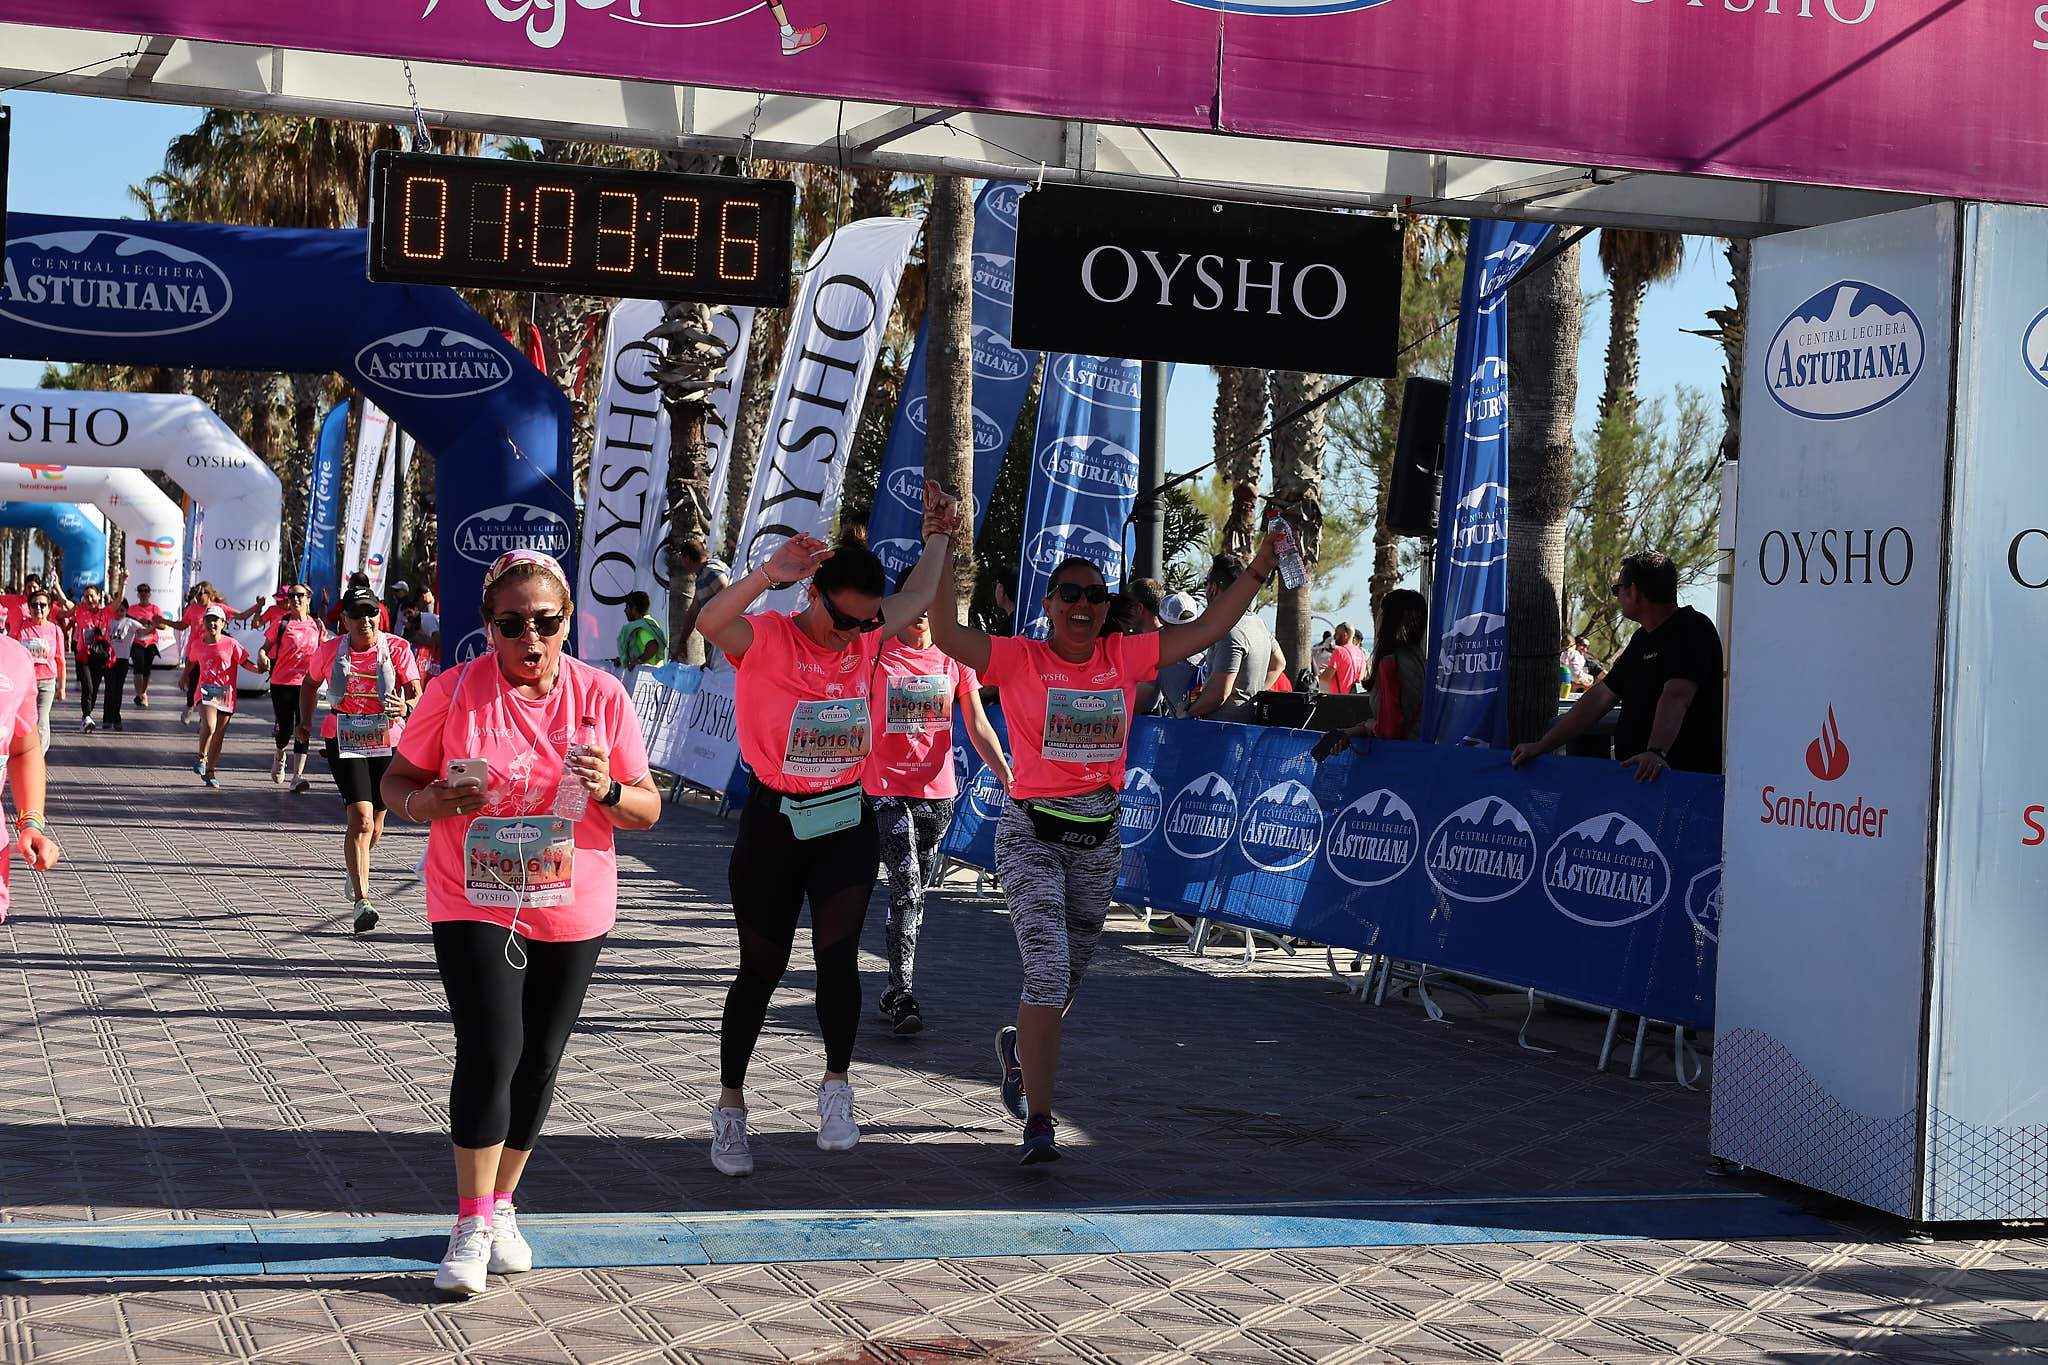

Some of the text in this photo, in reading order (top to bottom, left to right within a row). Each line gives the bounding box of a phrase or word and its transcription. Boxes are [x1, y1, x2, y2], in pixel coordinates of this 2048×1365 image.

[404, 176, 760, 281] 01:03:26
[31, 257, 205, 280] CENTRAL LECHERA
[0, 256, 213, 314] ASTURIANA
[1081, 245, 1347, 320] OYSHO
[1798, 321, 1907, 347] CENTRAL LECHERA
[368, 353, 504, 380] ASTURIANA
[389, 351, 496, 360] CENTRAL LECHERA
[1774, 339, 1911, 389] ASTURIANA
[1060, 358, 1141, 399] ASTURIA
[0, 404, 129, 447] SHO
[186, 455, 246, 469] OYSHO
[590, 339, 667, 607] OYSHO
[1046, 448, 1138, 490] ASTURIANA
[312, 460, 335, 549] Marlene
[215, 537, 271, 553] OYSHO
[461, 527, 566, 551] ASTURIANA
[1758, 526, 1914, 586] OYSHO
[820, 712, 850, 720] ASTURIANA
[907, 702, 931, 711] 016
[816, 734, 848, 747] 016
[1073, 722, 1103, 734] 016
[1050, 750, 1078, 759] OYSHO
[792, 764, 821, 773] OYSHO
[1168, 801, 1230, 839] ASTURIANA
[1760, 785, 1888, 838] Santander
[498, 831, 540, 840] ASTURIANA
[1242, 810, 1315, 852] ASTURIANA
[1351, 820, 1412, 835] CENTRAL LECHERA
[1454, 830, 1529, 848] CENTRAL LECHERA
[1330, 821, 1409, 864] ASTURIANA
[500, 858, 540, 873] 016
[1430, 831, 1525, 881] ASTURIANA
[1573, 847, 1656, 870] CENTRAL LECHERA
[471, 881, 498, 889] CARRERA
[540, 881, 567, 890] VALENCIA
[1549, 847, 1652, 905] ASTURIANA
[476, 892, 510, 902] OYSHO
